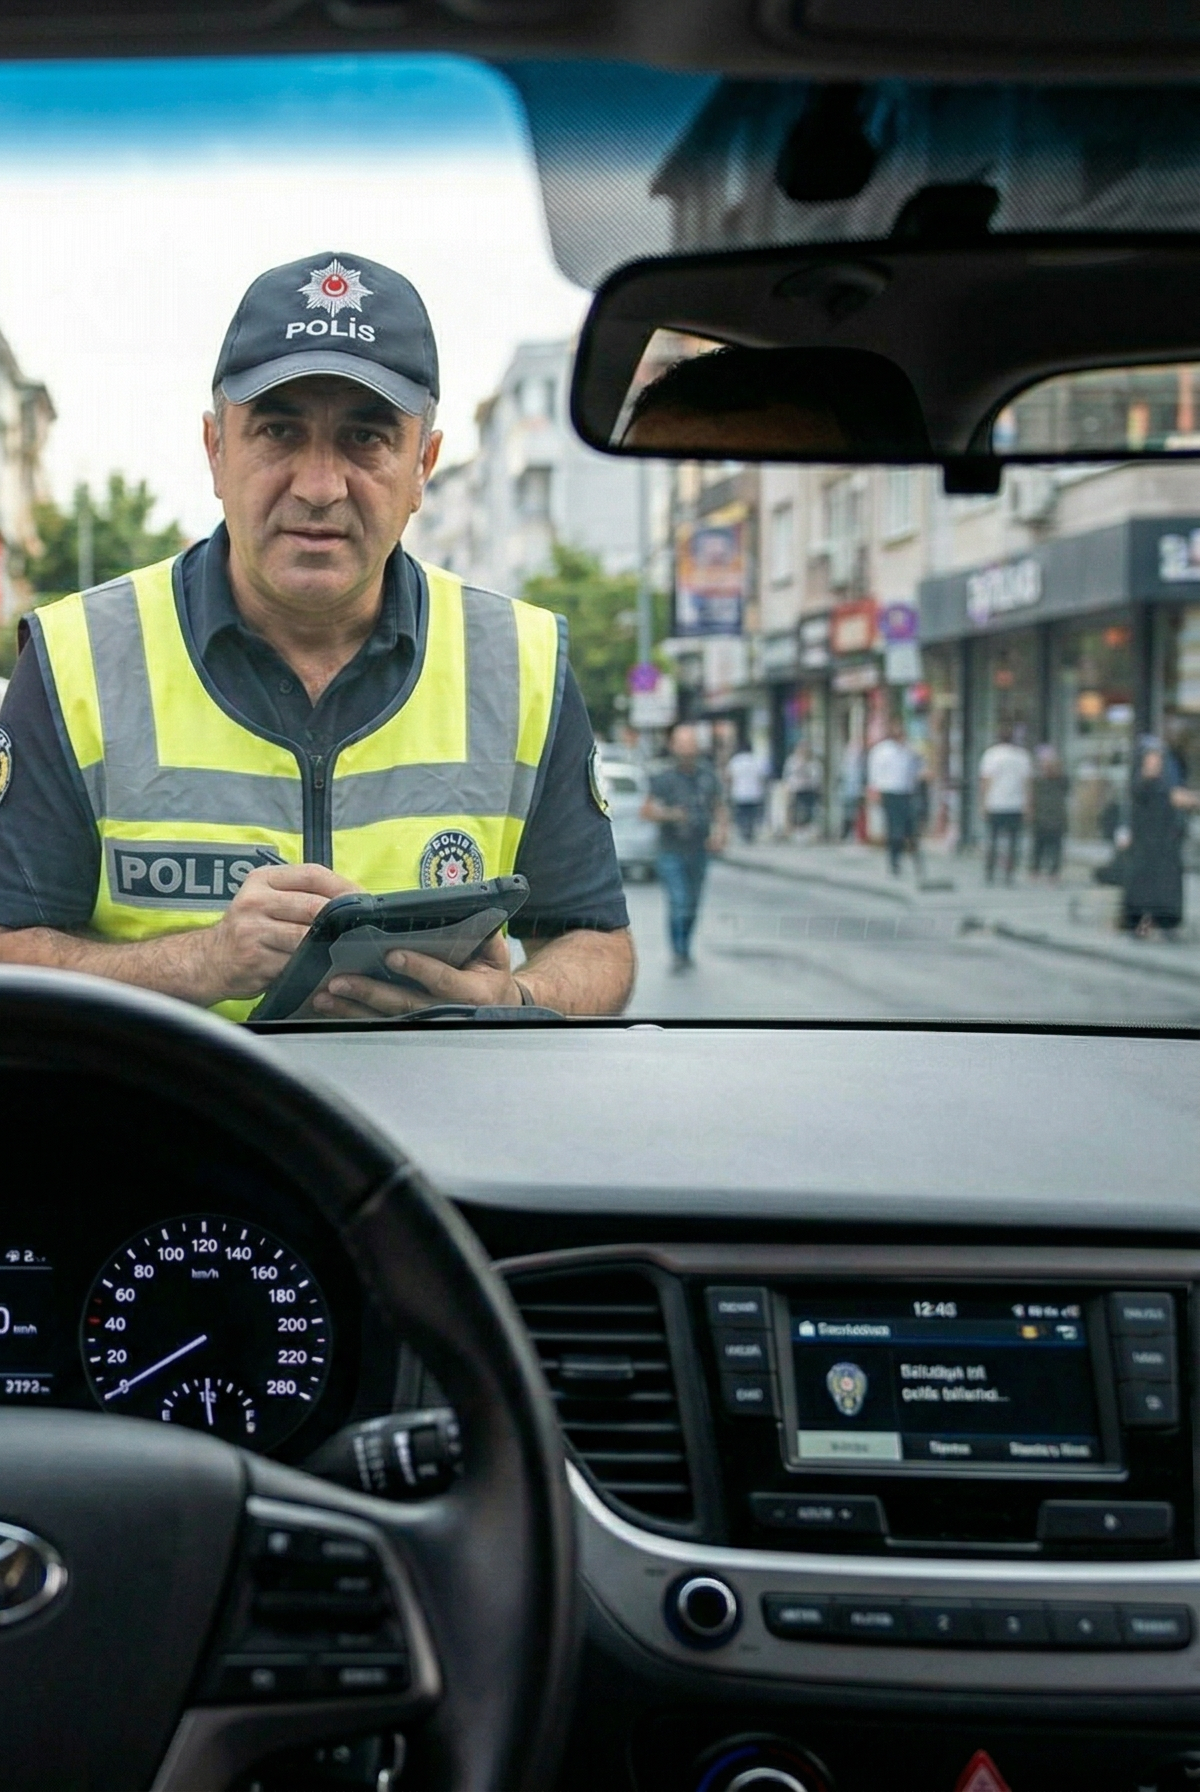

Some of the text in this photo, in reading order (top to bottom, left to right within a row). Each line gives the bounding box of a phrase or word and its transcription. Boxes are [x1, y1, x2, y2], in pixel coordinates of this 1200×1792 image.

[191, 1238, 218, 1253] 120
[224, 1246, 253, 1261] 140
[157, 1246, 185, 1262] 100
[133, 1264, 155, 1279] 80
[250, 1265, 279, 1280] 160
[114, 1287, 136, 1303] 60
[268, 1288, 296, 1304] 180
[104, 1316, 127, 1332] 40
[277, 1317, 308, 1333] 200
[106, 1349, 128, 1364] 20
[277, 1349, 308, 1365] 220
[266, 1379, 297, 1395] 280
